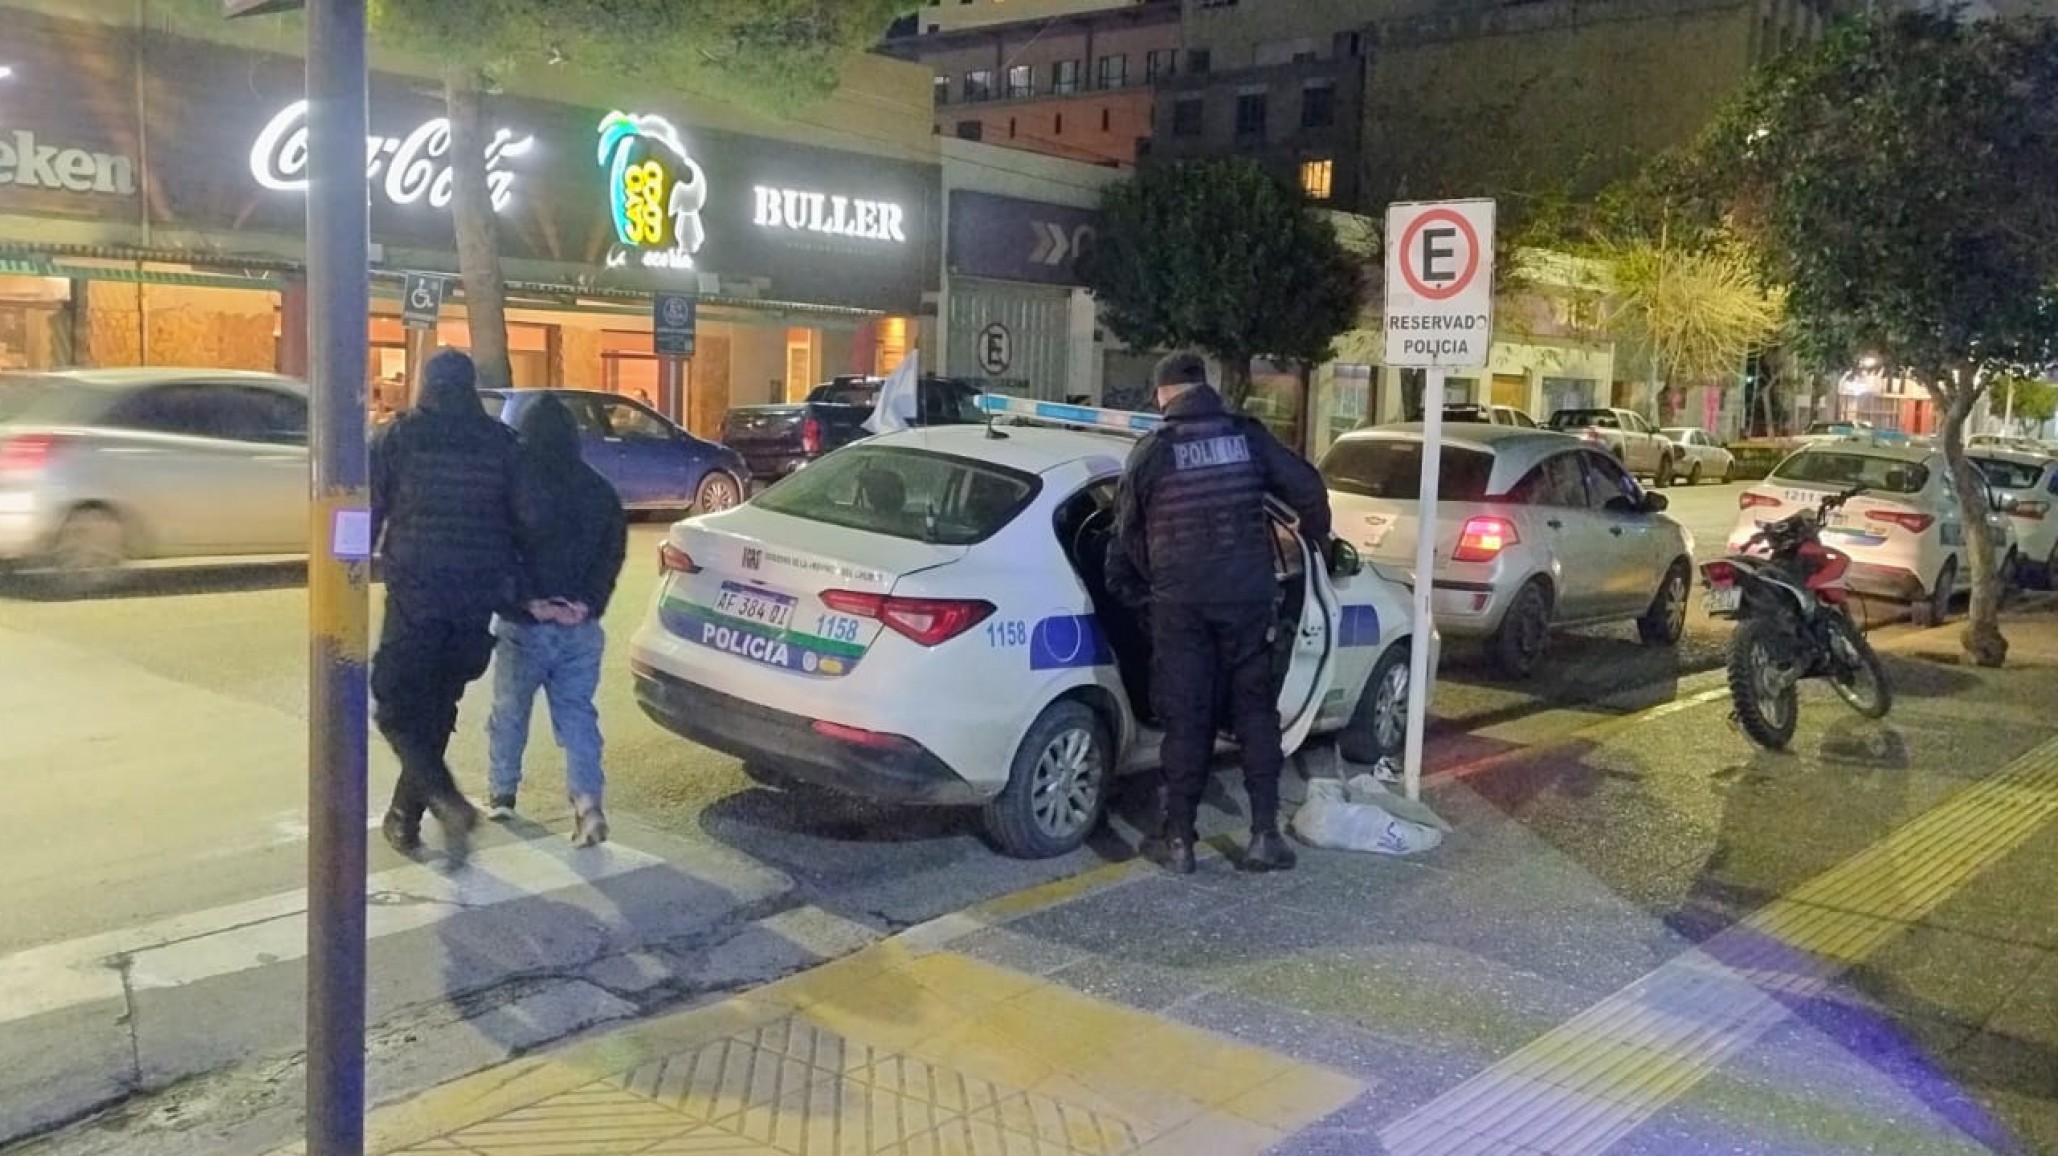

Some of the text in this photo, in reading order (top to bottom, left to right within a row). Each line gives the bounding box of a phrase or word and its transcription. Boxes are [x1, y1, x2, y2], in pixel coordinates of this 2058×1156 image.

[752, 184, 907, 242] BULLER
[1422, 227, 1456, 281] E
[1389, 314, 1487, 331] RESERVADO
[1403, 339, 1468, 355] POLICIA
[739, 596, 766, 619] 384
[816, 613, 860, 641] 1158
[987, 621, 1026, 648] 1158
[702, 622, 789, 667] POLICIA
